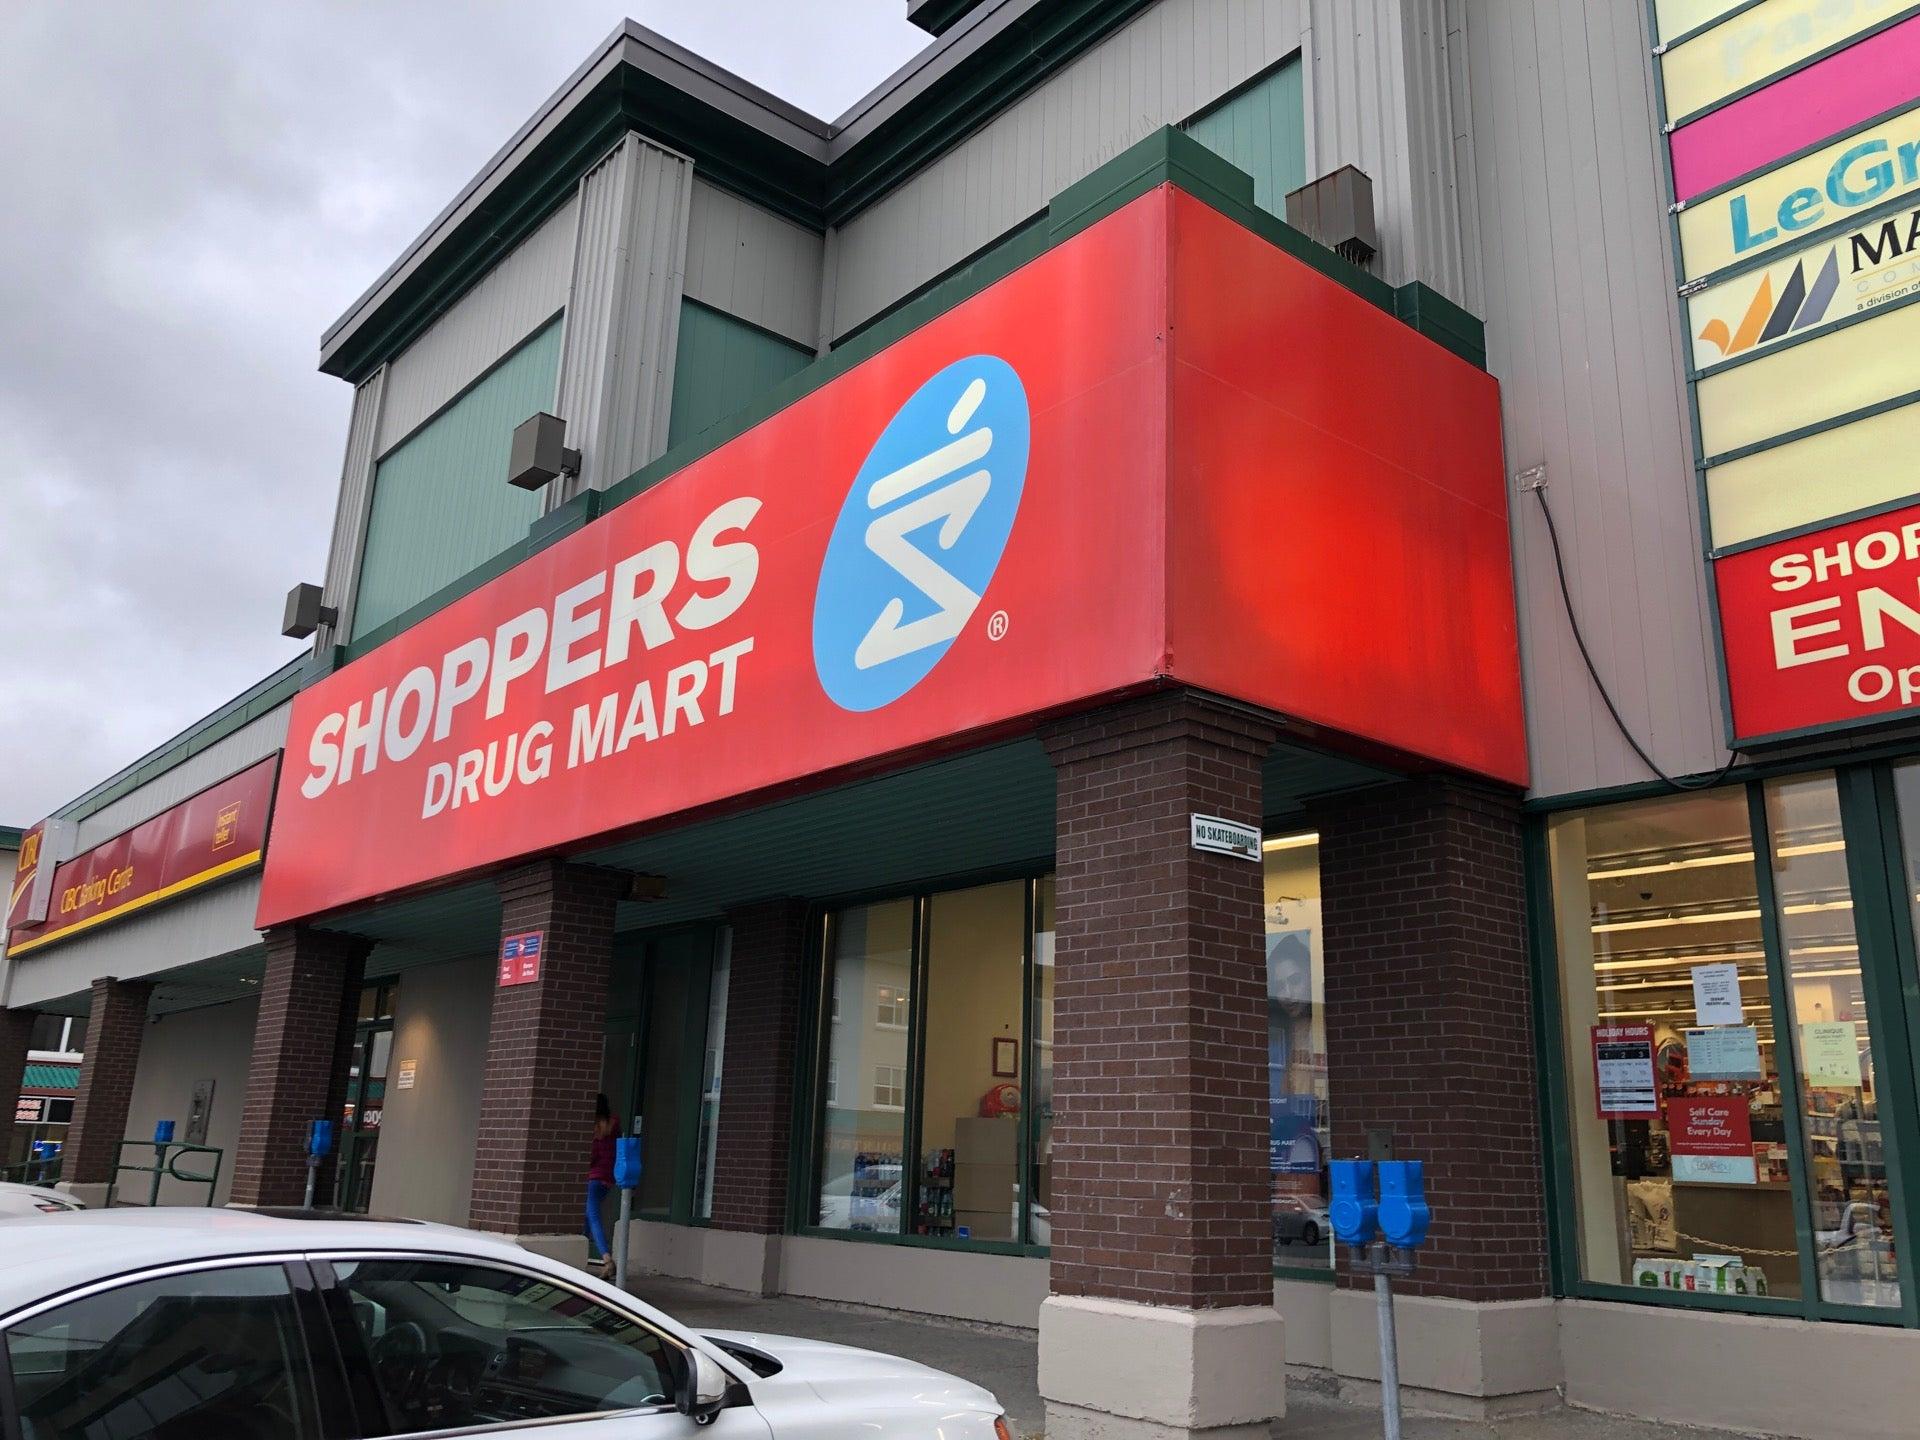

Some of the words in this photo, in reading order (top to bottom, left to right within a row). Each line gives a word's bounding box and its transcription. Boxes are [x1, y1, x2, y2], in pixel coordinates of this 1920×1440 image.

[1857, 303, 1864, 311] a
[1866, 286, 1909, 307] division
[1769, 576, 1920, 670] EN
[301, 496, 763, 799] SHOPPERS
[1847, 664, 1920, 705] Op
[421, 720, 554, 820] DRUG
[567, 637, 754, 770] MART
[1195, 824, 1206, 839] NO
[1207, 826, 1258, 851] SKATEBOARDING
[1596, 1028, 1623, 1037] HOLIDAY
[1624, 1026, 1649, 1036] HOURS
[1689, 1107, 1706, 1116] Self
[1707, 1107, 1730, 1117] Care
[1691, 1117, 1725, 1127] Sunday
[1687, 1126, 1712, 1138] Every
[1713, 1127, 1732, 1138] Day
